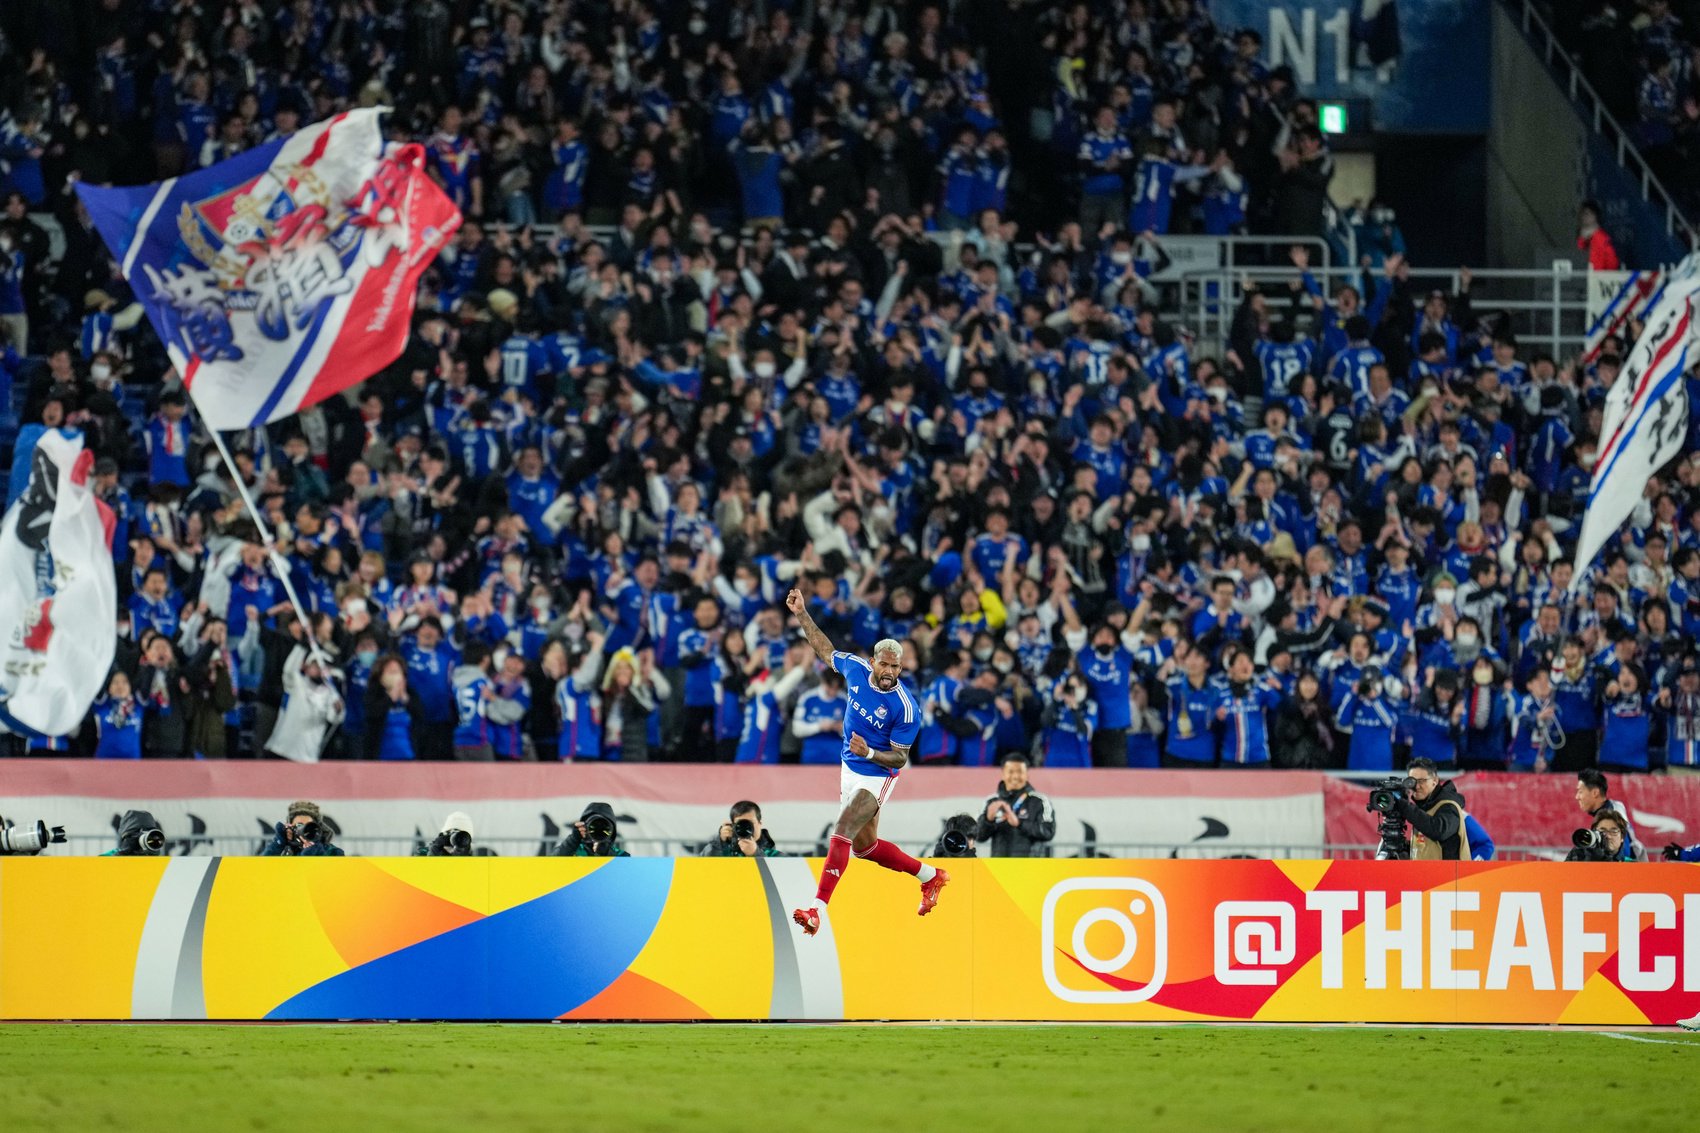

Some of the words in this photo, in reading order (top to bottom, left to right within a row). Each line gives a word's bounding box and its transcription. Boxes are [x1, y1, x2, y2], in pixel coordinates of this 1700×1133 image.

[1268, 7, 1397, 84] N1
[502, 350, 528, 386] 10
[1329, 429, 1348, 461] 6
[1214, 889, 1700, 992] @THEAFC
